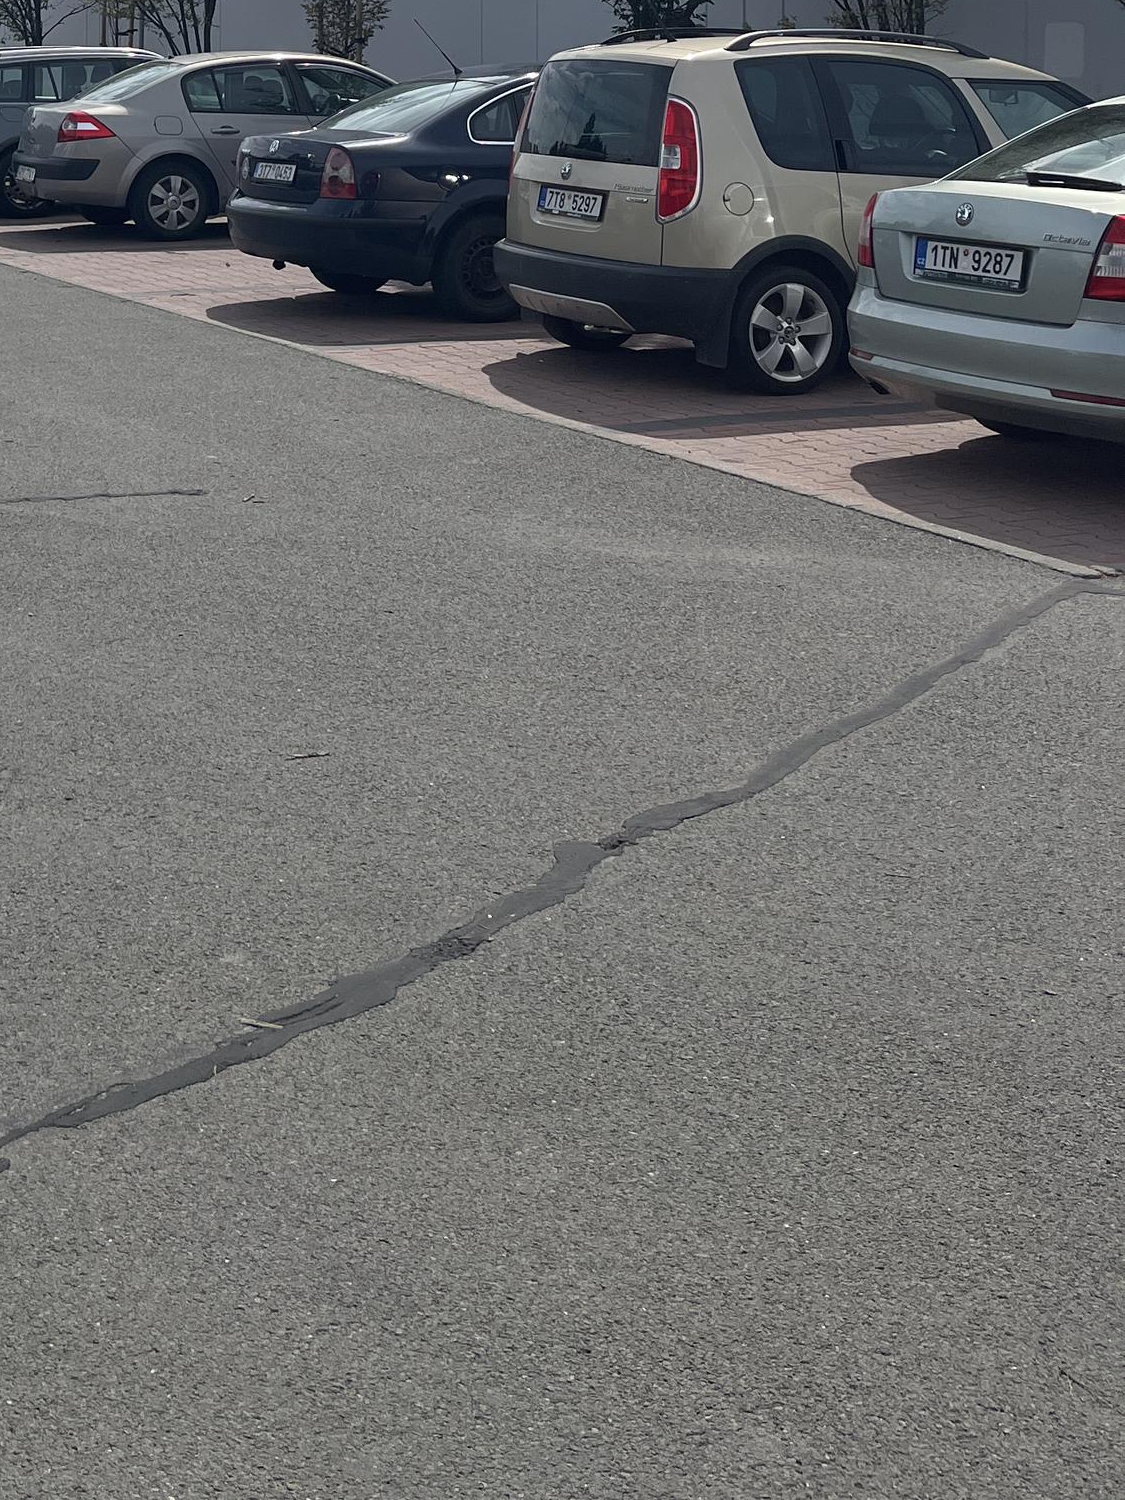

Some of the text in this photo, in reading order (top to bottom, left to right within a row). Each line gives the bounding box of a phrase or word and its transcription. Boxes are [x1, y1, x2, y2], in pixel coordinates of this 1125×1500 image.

[546, 190, 566, 208] 7T8
[571, 195, 598, 213] 5297
[930, 244, 1015, 276] 1TN 9287
